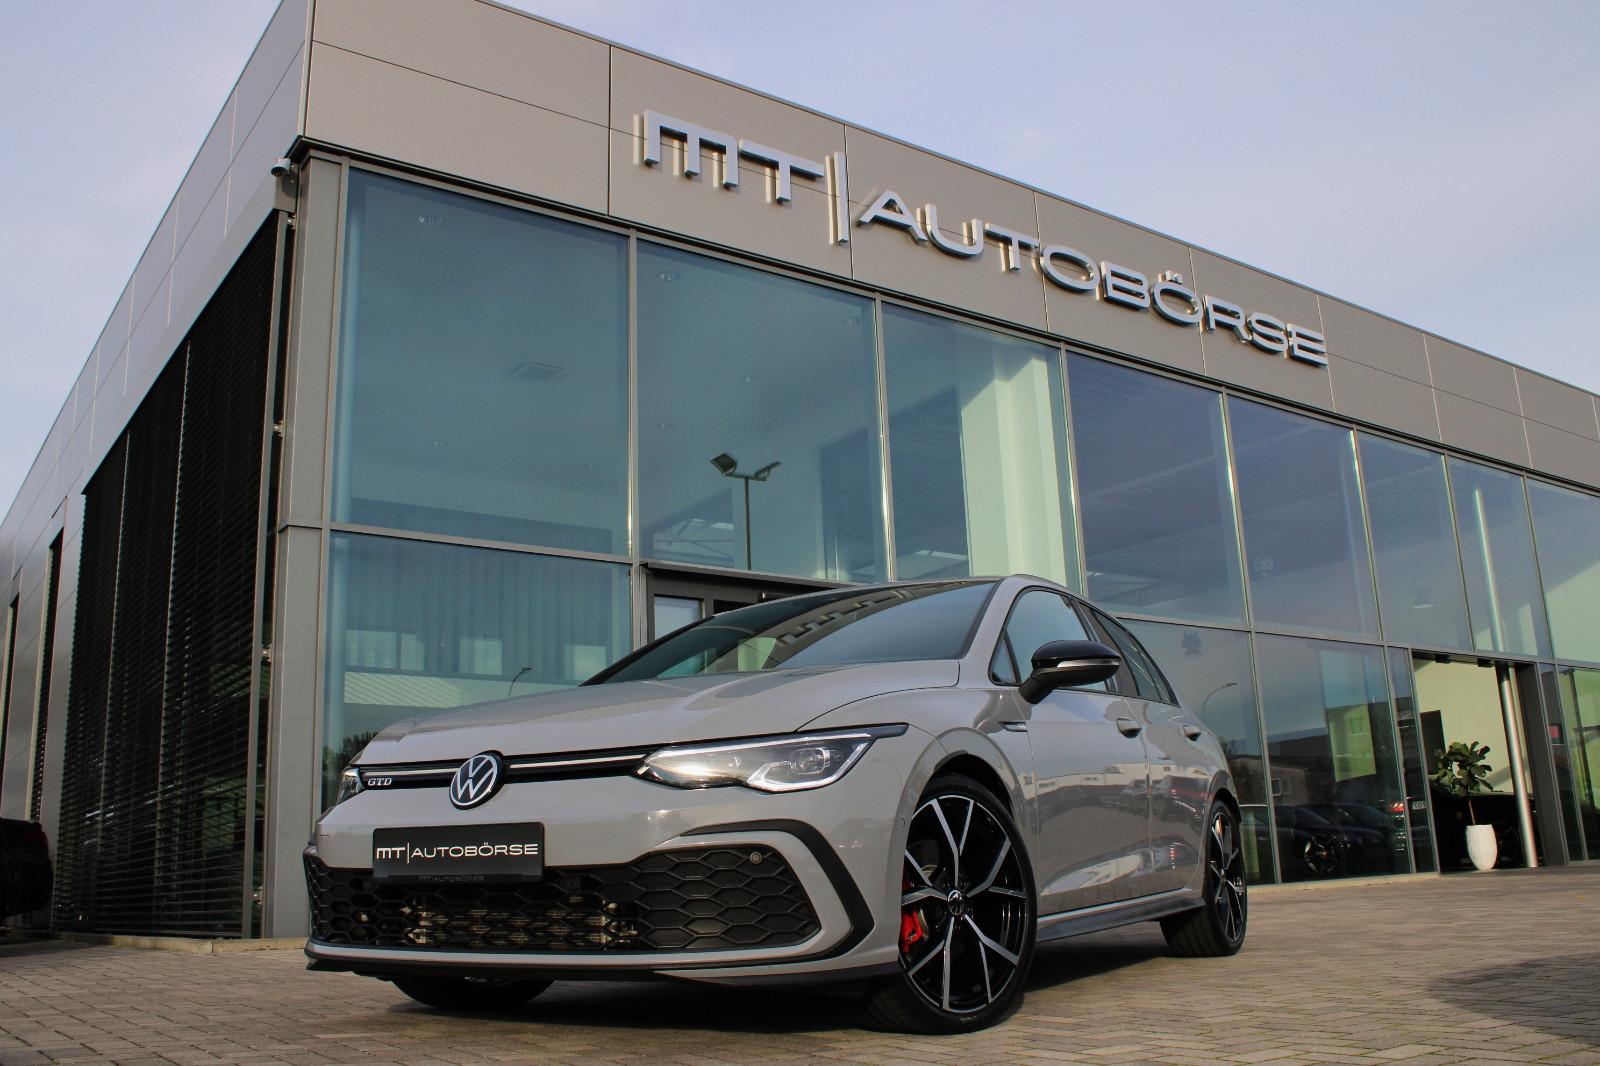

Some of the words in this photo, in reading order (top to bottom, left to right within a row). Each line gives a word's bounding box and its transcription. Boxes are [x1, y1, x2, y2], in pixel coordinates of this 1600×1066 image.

[857, 190, 1328, 366] AUTOBÖRSE
[367, 777, 392, 786] GTD
[411, 842, 539, 858] AUTOBÖRSE
